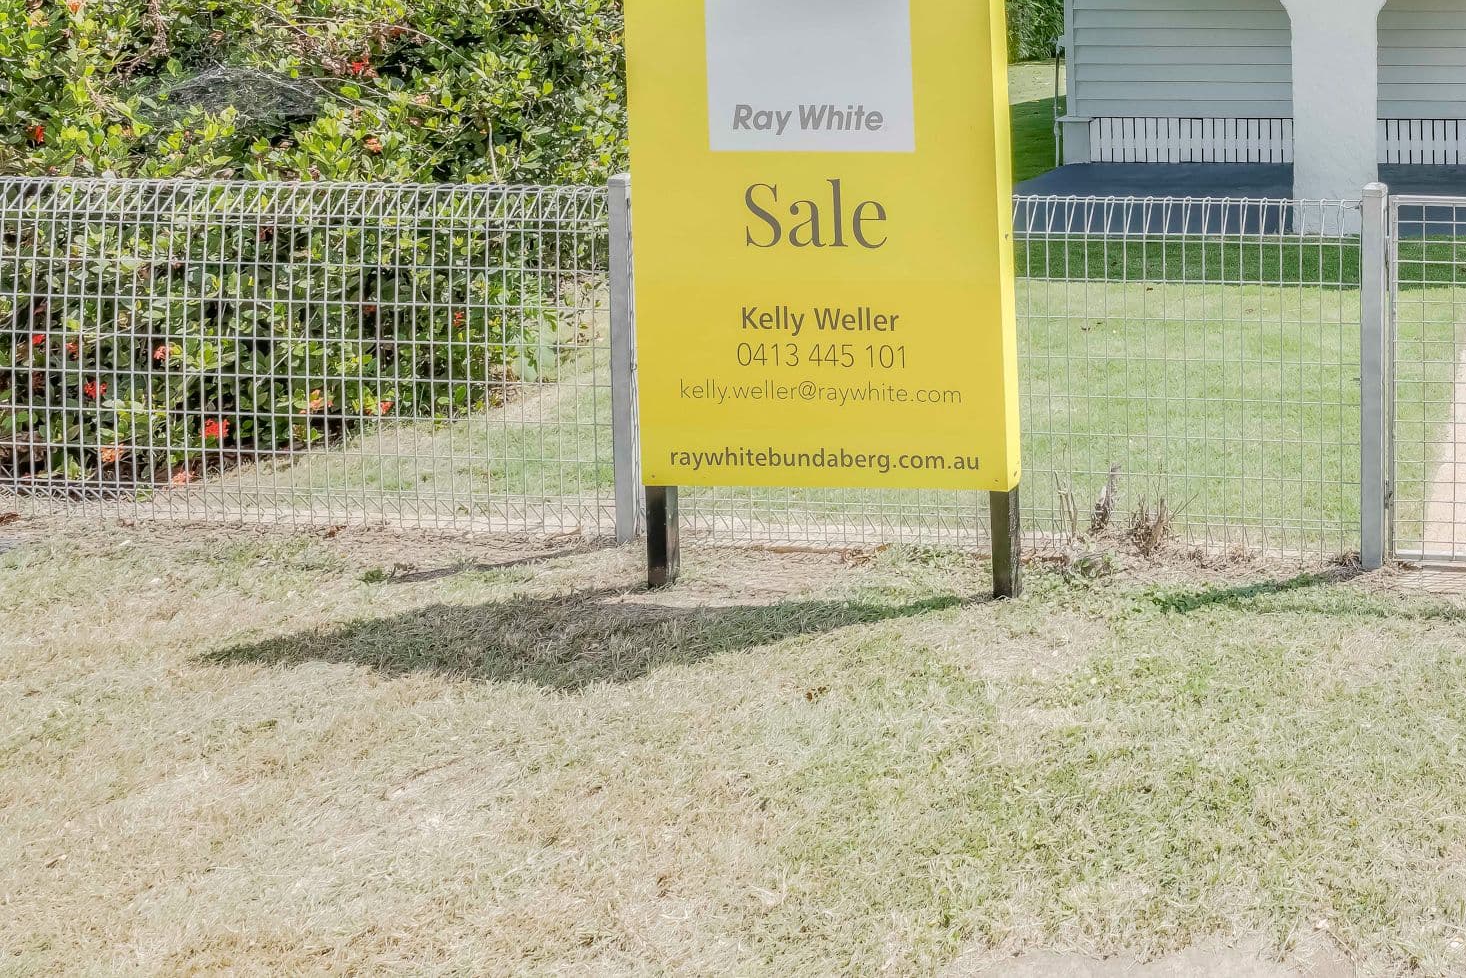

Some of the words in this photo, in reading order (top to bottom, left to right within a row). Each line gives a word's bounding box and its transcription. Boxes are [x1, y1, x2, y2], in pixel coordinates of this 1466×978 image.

[732, 104, 791, 135] Ray
[798, 104, 884, 132] White
[744, 178, 888, 249] Sale
[741, 306, 805, 337] Kelly
[813, 307, 899, 332] Weller
[736, 341, 800, 368] 0413
[808, 343, 855, 369] 445
[865, 344, 908, 370] 101
[679, 378, 963, 406] kelly.weller@raywhite.com
[669, 447, 981, 473] raywhitebundaberg.com.au
